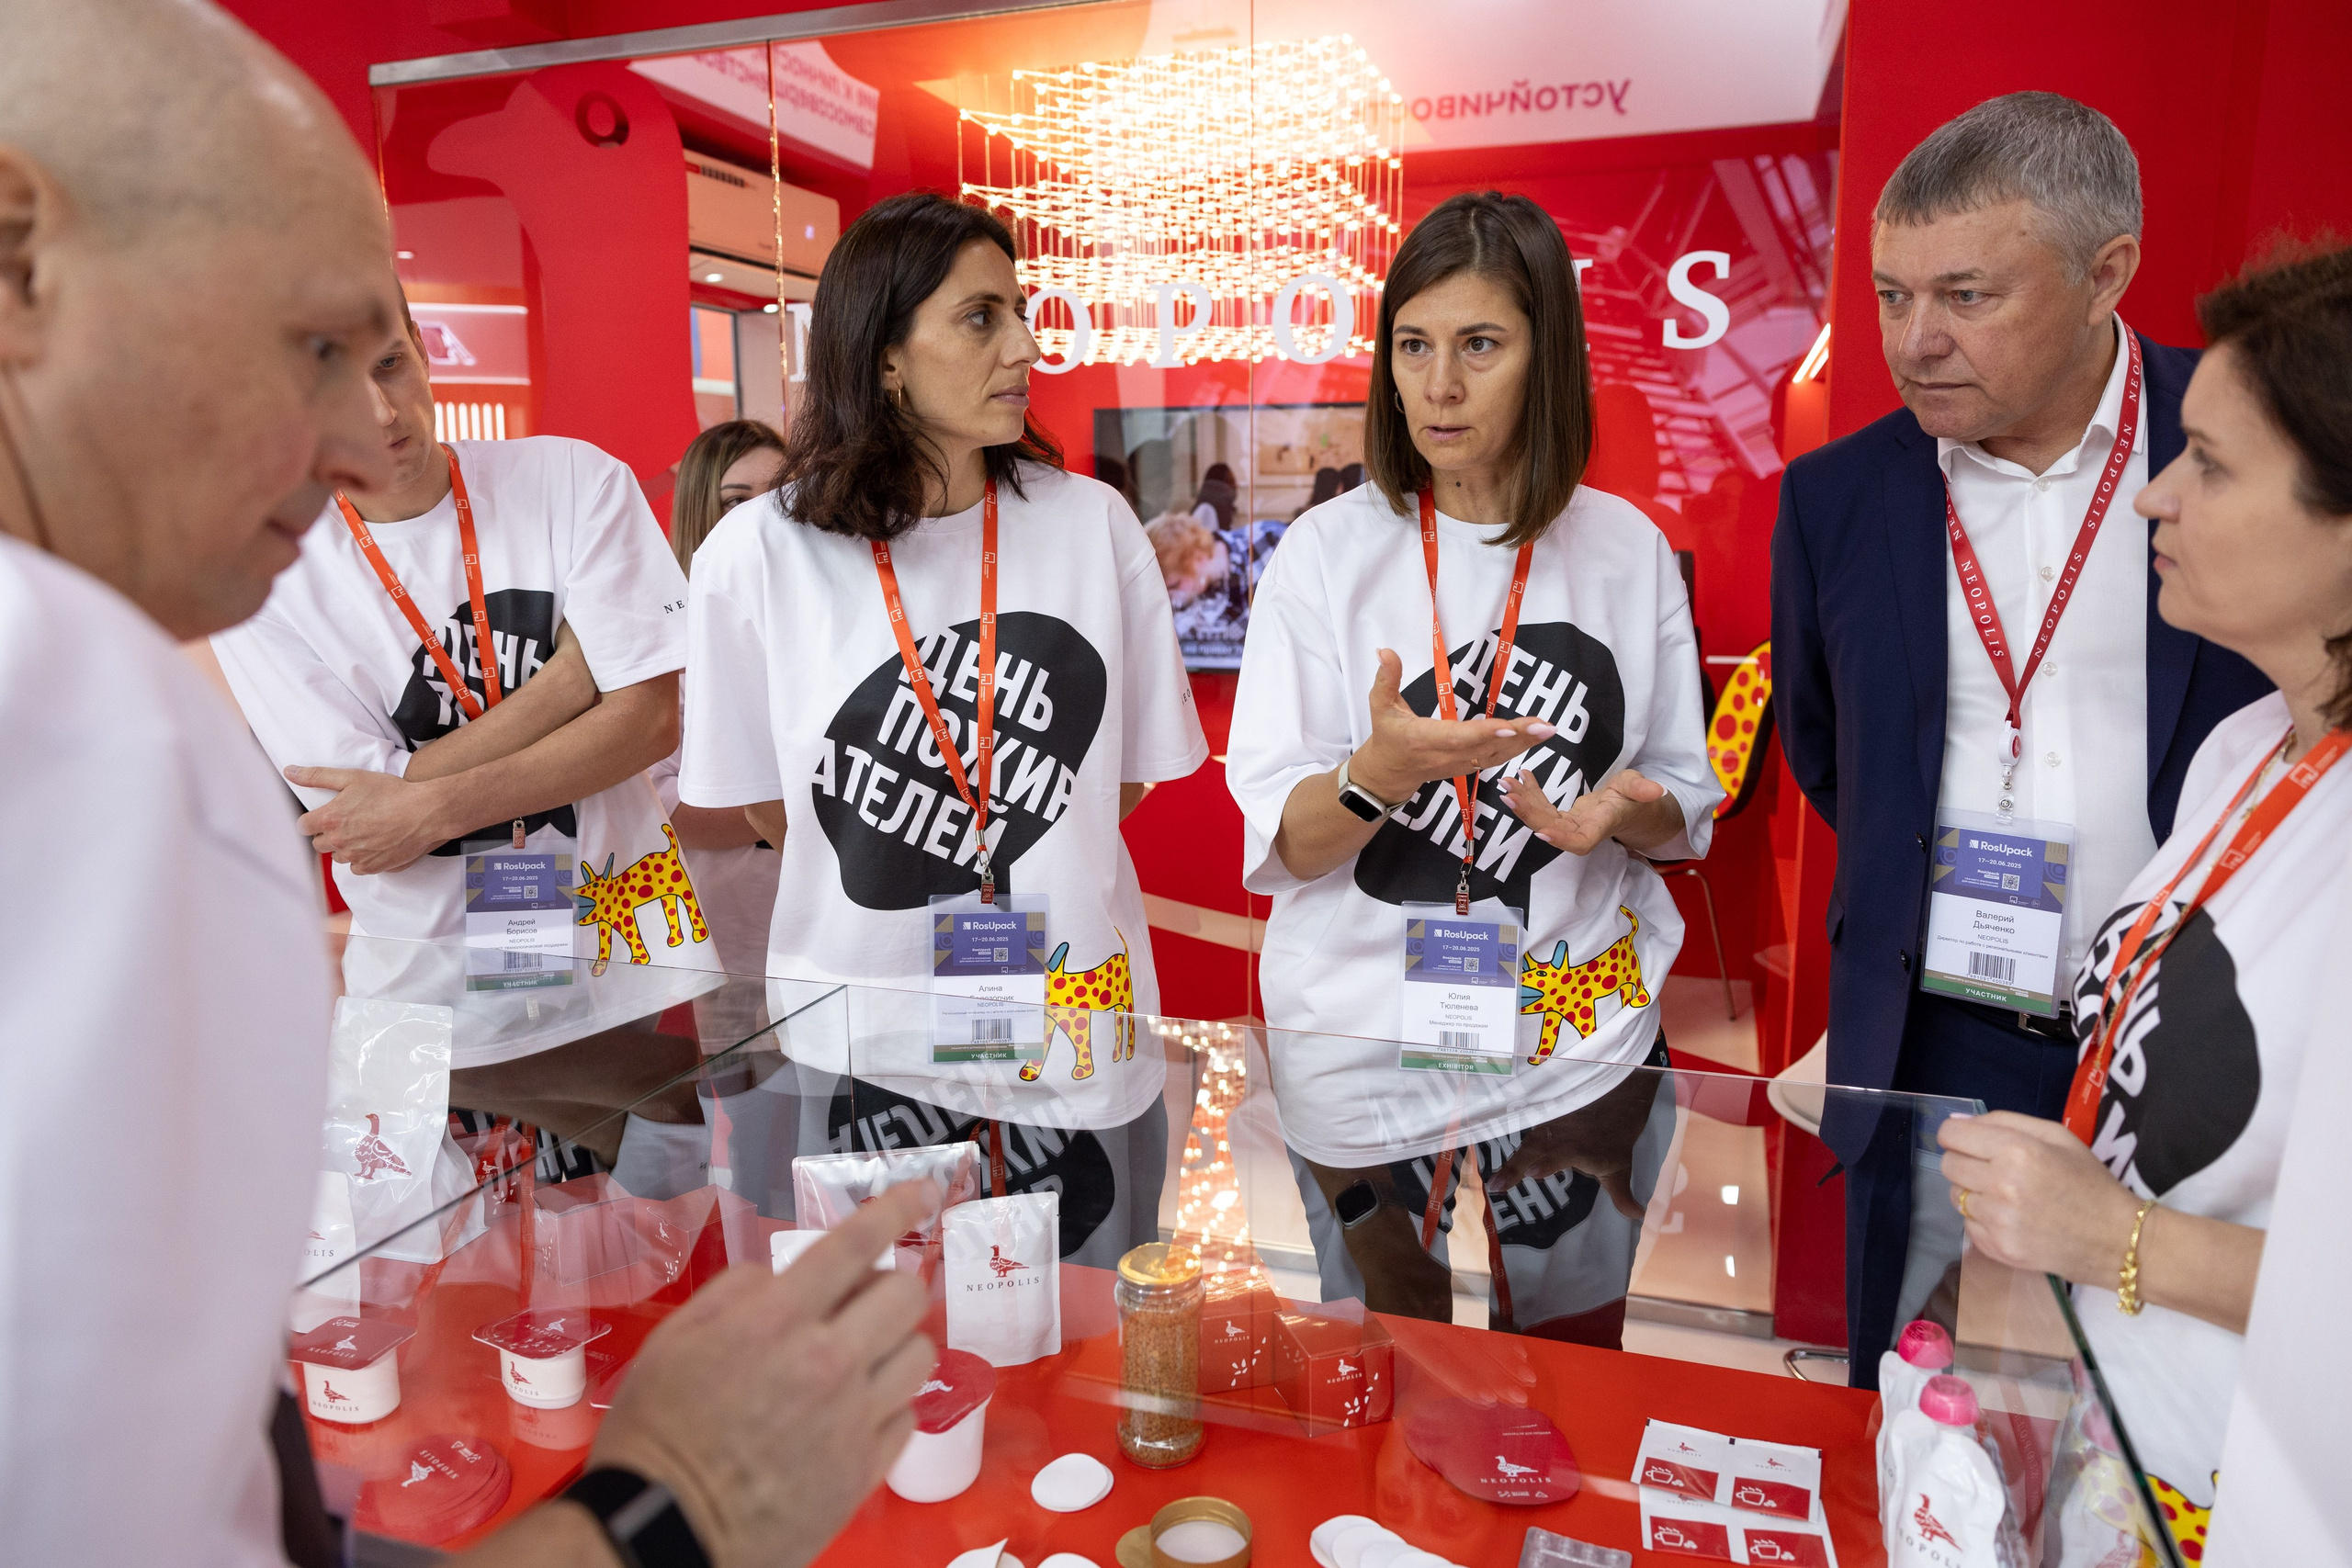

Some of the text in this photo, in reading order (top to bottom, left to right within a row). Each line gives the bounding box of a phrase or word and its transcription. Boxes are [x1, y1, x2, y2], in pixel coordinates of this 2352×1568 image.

[2087, 423, 2132, 530] NEOPOLIS
[1960, 559, 2004, 660] NEOPOLIS
[2034, 551, 2082, 660] NEOPOLIS
[897, 626, 1055, 733] ДЕНЬ
[1452, 631, 1591, 745] ДЕНЬ
[1980, 840, 2033, 858] RosUpack
[503, 862, 546, 872] RosUpack
[1975, 909, 2014, 923] Валерий
[972, 921, 1017, 931] RosUpack
[1973, 920, 2015, 935] Дьяченко
[1444, 930, 1488, 941] RosUpack
[1937, 935, 1958, 943] Директор
[1977, 934, 2008, 944] NEOPOLIS
[1448, 992, 1470, 1000] Юлия
[1965, 987, 2007, 1002] УЧАСТНИК
[1440, 1001, 1478, 1011] Тюленева
[1438, 1062, 1475, 1071] EXHIBITOR
[966, 1276, 1041, 1292] NEOPOLIS
[525, 1324, 562, 1341] NEOPOLIS
[1214, 1335, 1251, 1344] NEOPOLIS
[307, 1347, 357, 1359] NEOPOLIS
[1326, 1372, 1363, 1385] NEOPOLIS
[311, 1400, 360, 1413] NEOPOLIS
[419, 1450, 460, 1480] NEOPOLIS
